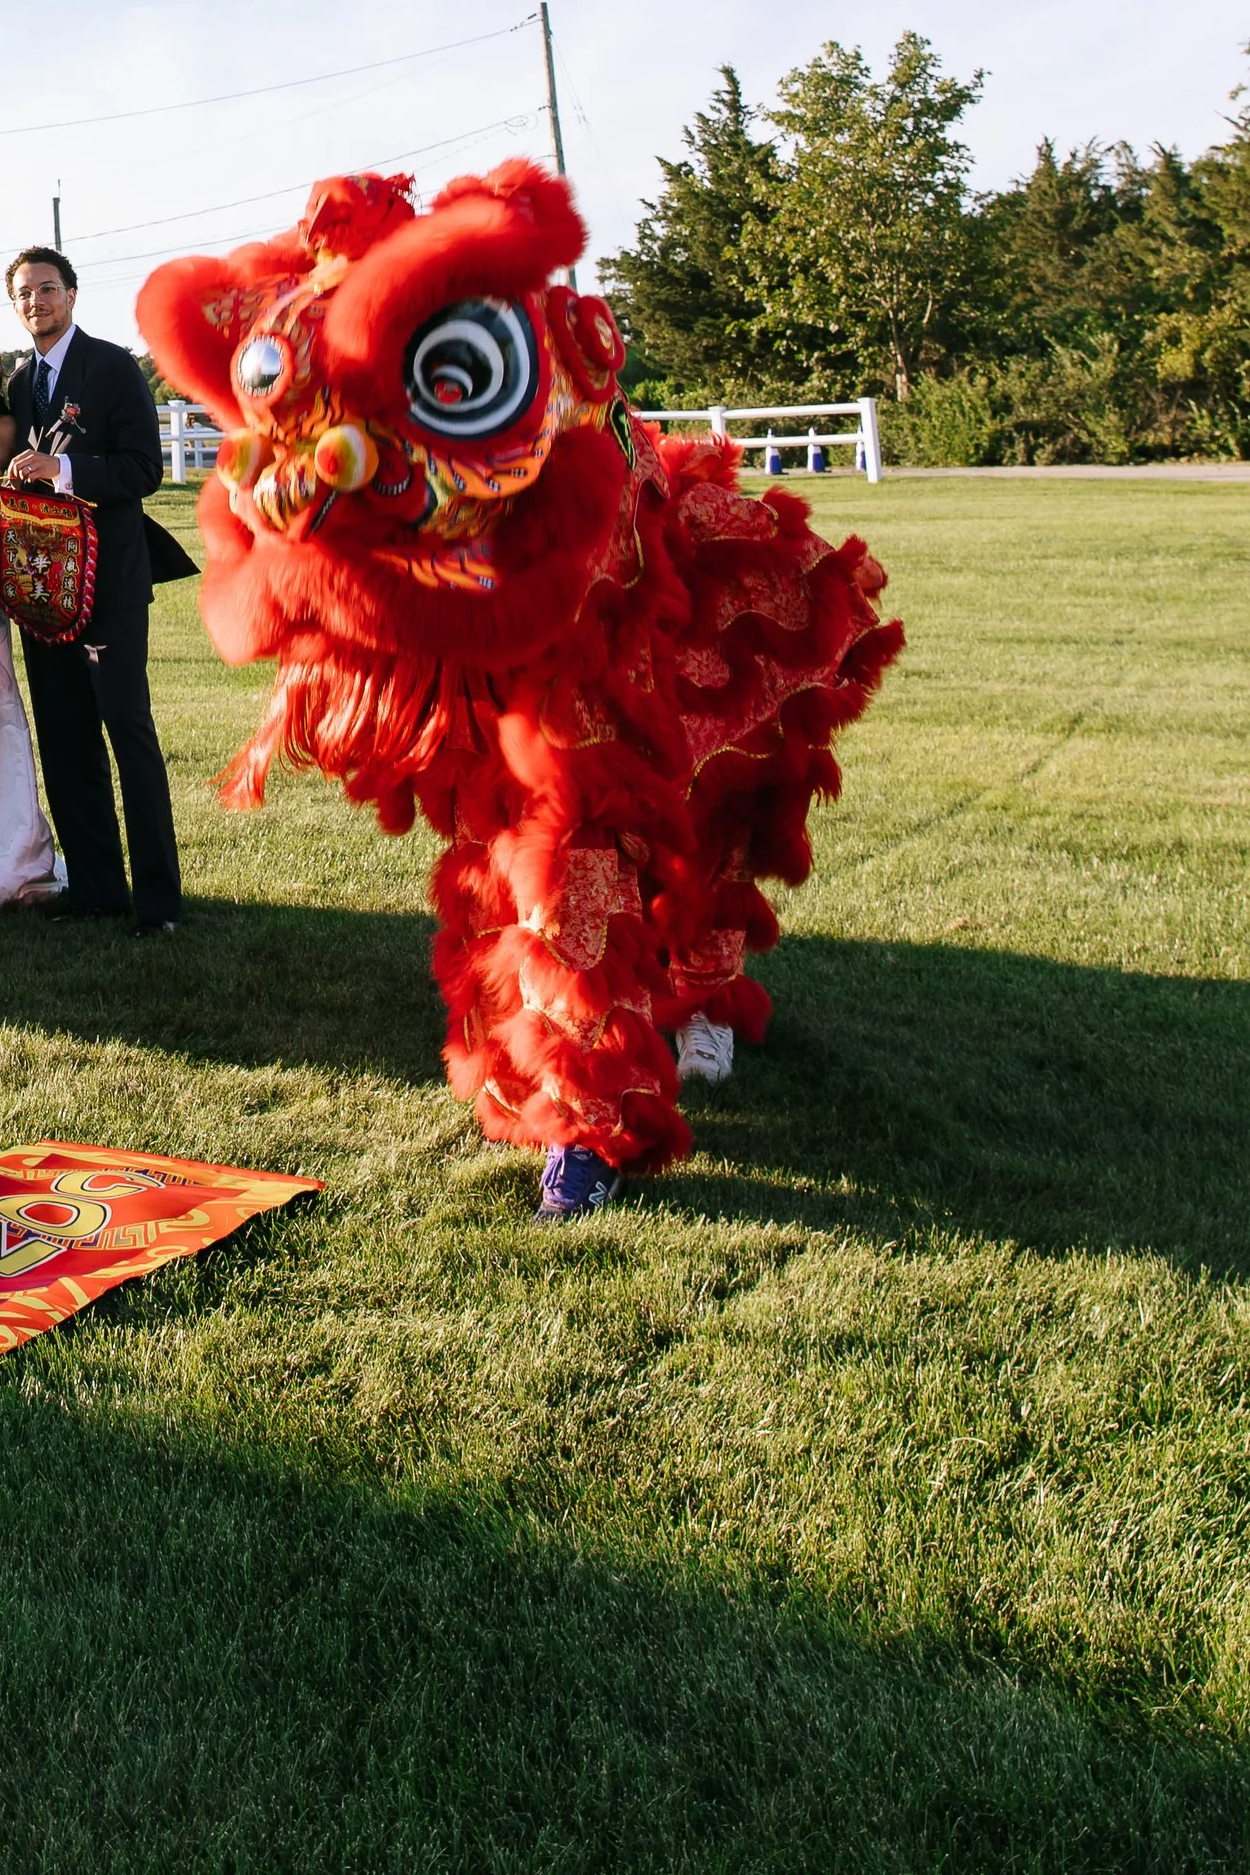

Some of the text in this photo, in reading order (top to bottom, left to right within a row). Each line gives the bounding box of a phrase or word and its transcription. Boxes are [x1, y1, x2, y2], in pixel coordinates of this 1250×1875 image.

[6, 530, 18, 598] 天下一家
[30, 552, 51, 602] 華美
